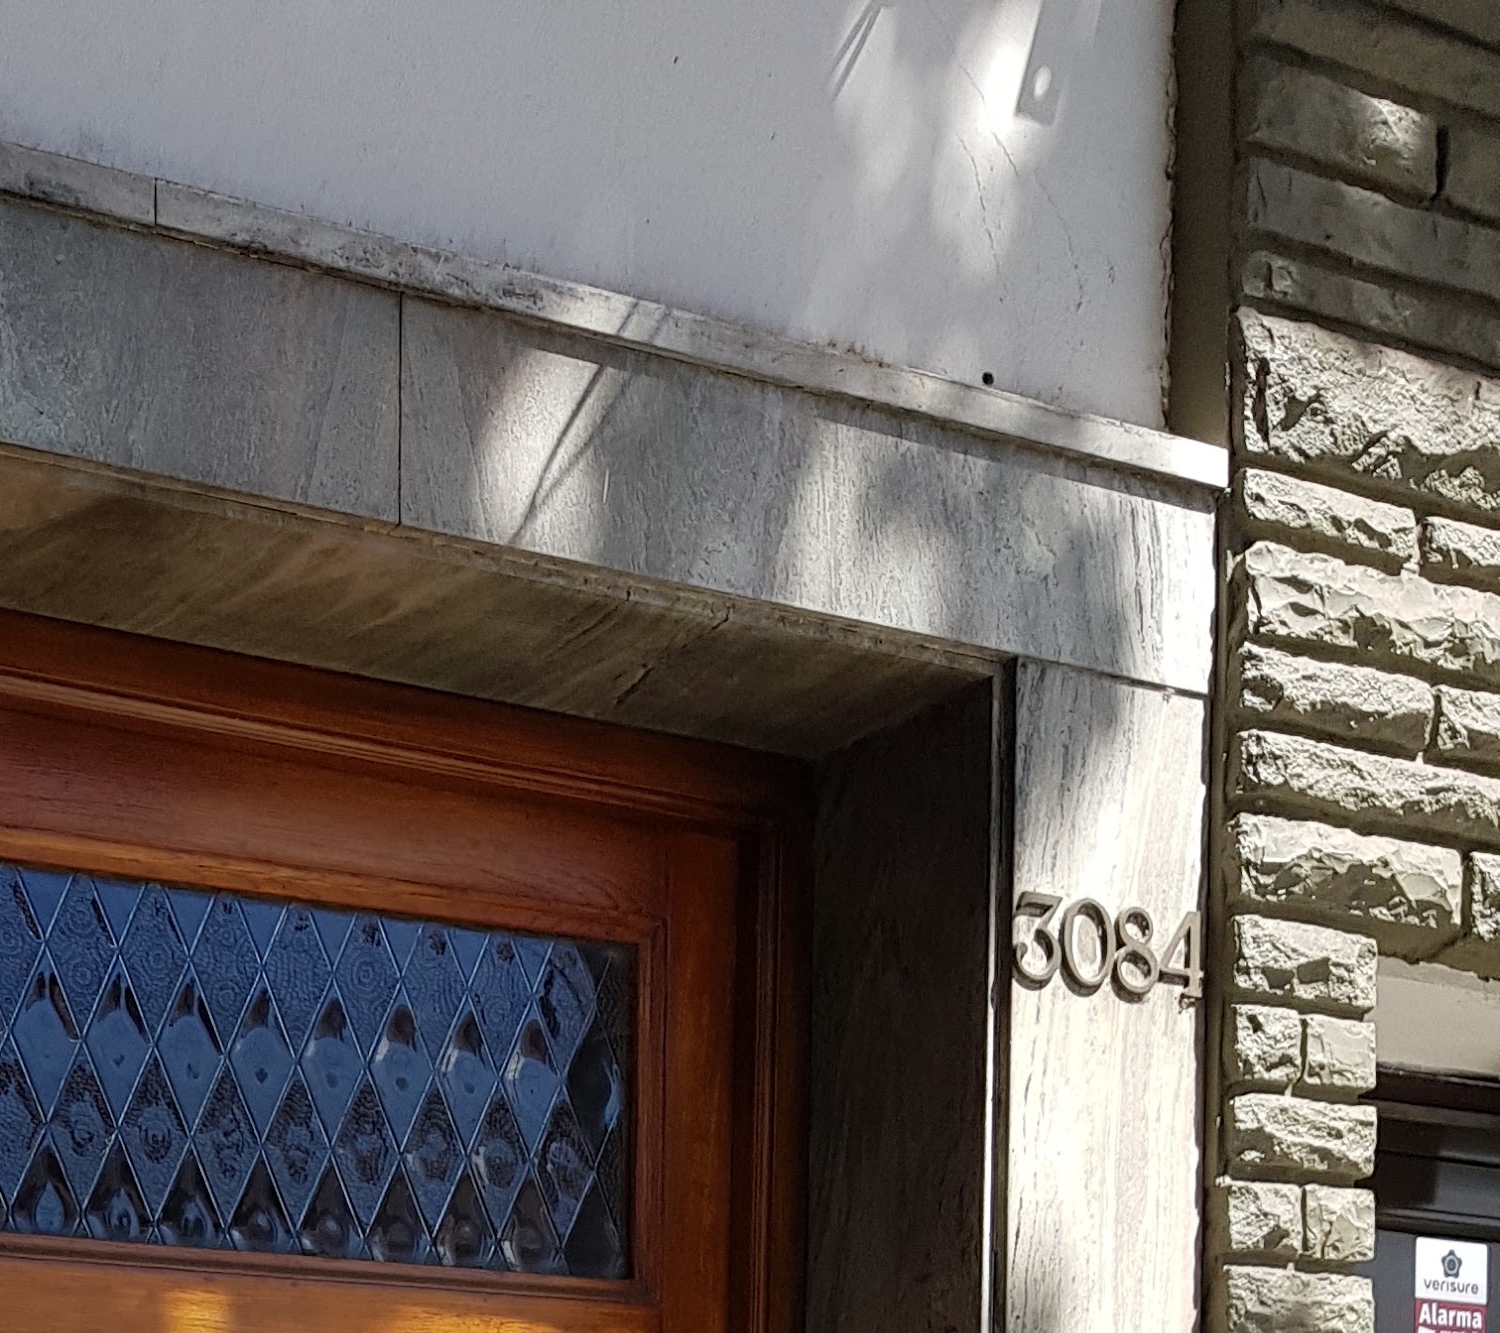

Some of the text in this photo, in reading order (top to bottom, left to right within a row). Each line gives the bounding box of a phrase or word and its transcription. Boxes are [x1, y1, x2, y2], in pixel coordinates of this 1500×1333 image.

[1012, 891, 1203, 1004] 3084
[1423, 1278, 1479, 1295] verisure
[1419, 1302, 1482, 1330] Alarma
